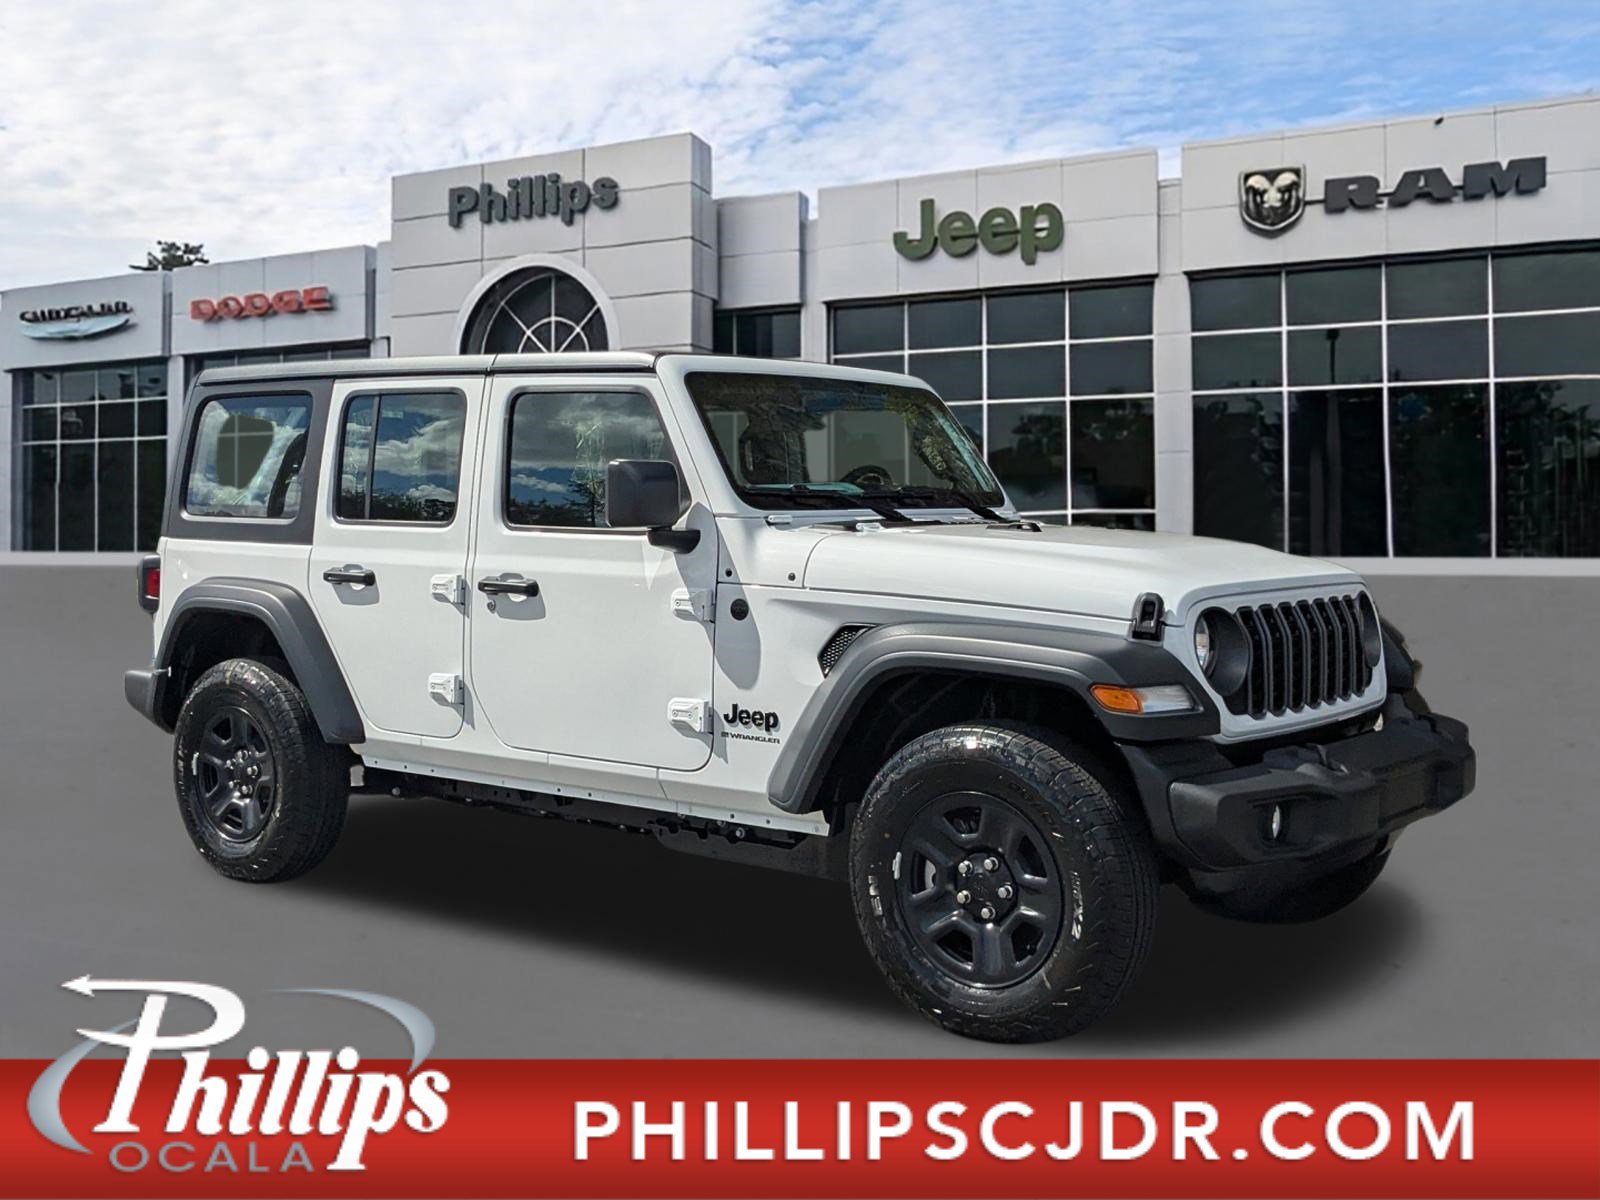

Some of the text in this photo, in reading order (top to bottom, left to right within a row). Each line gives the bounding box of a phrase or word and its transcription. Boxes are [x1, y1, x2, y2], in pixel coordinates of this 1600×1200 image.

[448, 172, 619, 229] Phillips
[1322, 156, 1547, 214] RAM
[893, 197, 1065, 266] Jeep
[190, 285, 333, 322] DODGE
[723, 703, 780, 733] Jeep
[730, 732, 780, 744] WRANGLER
